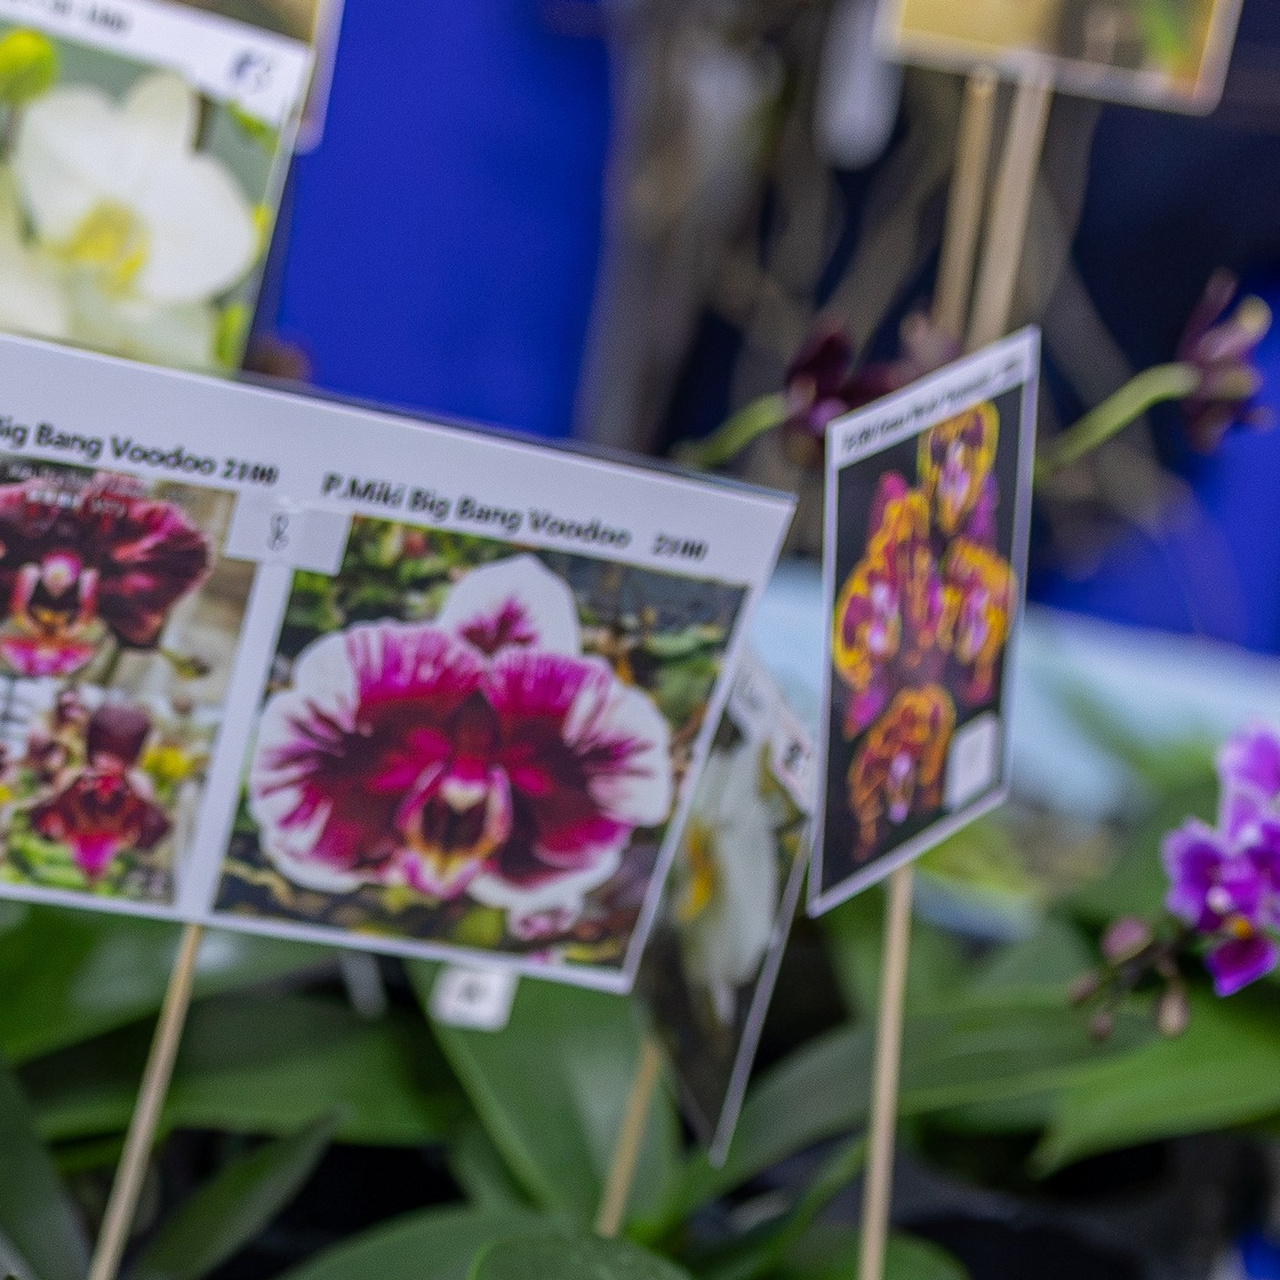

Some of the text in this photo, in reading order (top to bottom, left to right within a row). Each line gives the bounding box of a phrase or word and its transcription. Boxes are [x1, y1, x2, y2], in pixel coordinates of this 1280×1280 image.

[35, 422, 103, 461] Bang
[111, 436, 217, 477] Voodoo
[408, 484, 450, 522] Big
[455, 495, 522, 535] Bang
[528, 507, 632, 550] Voodoo
